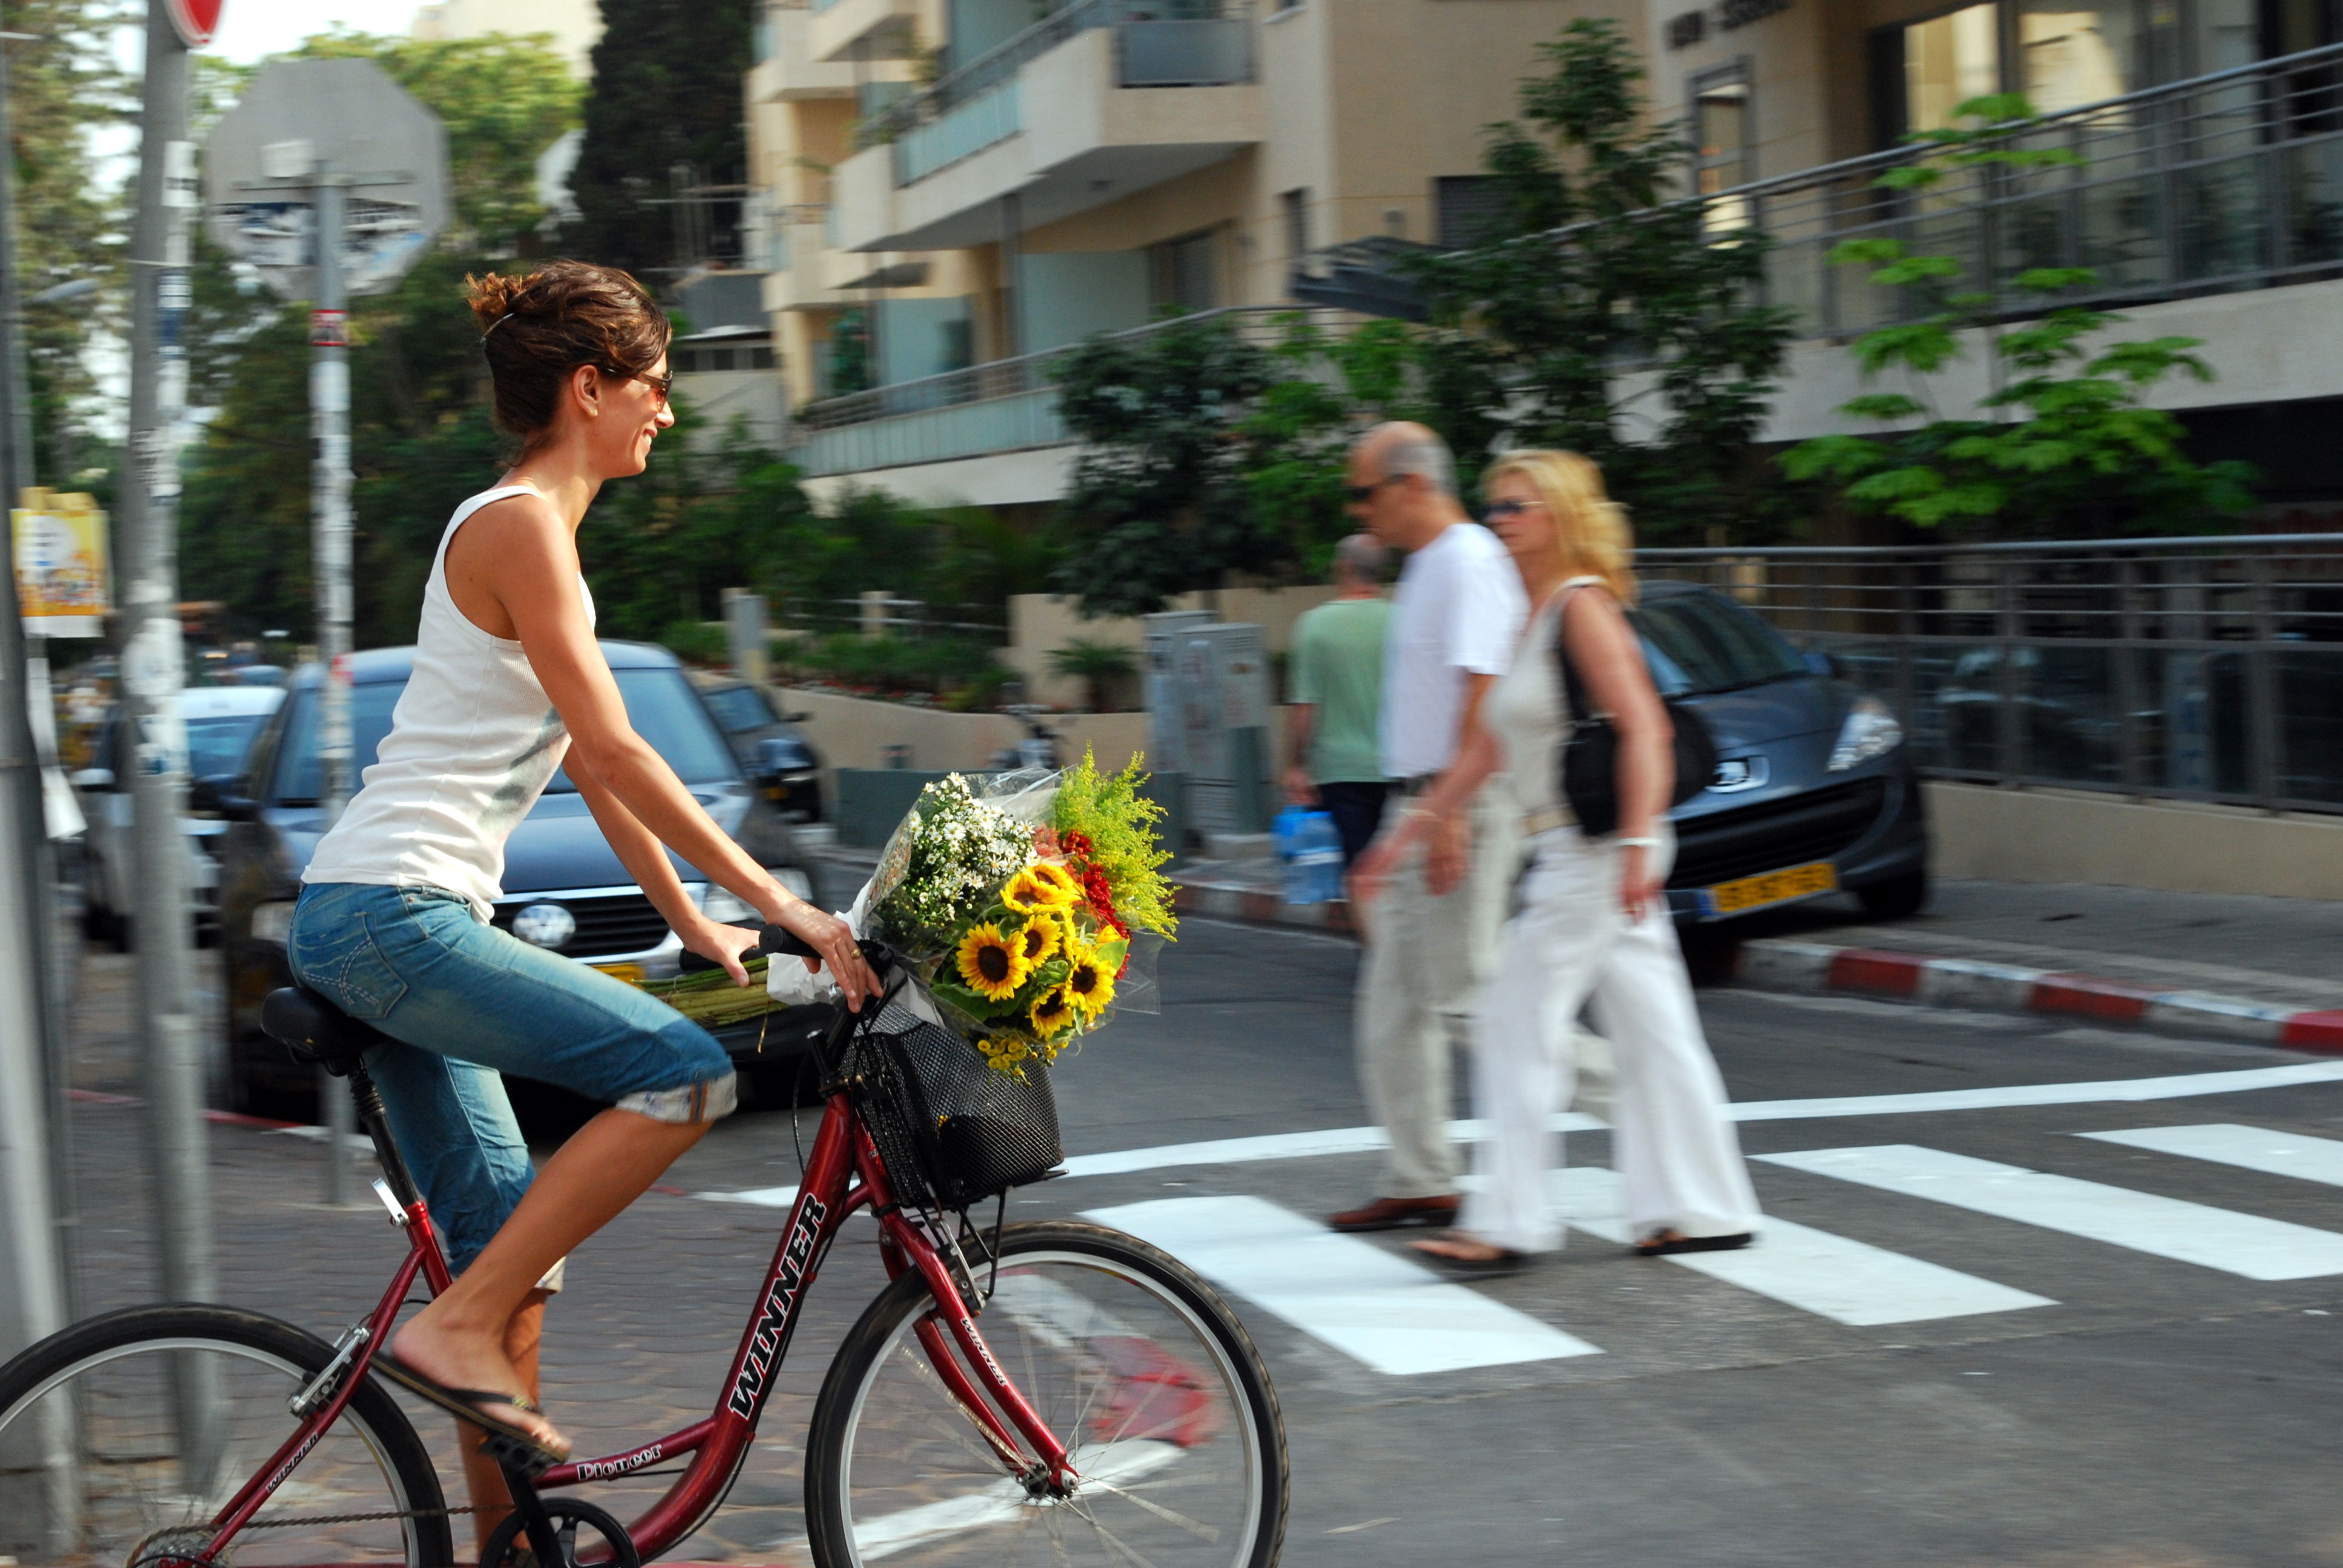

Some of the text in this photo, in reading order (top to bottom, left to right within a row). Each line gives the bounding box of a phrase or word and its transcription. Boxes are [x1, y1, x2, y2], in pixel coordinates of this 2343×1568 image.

[728, 1192, 827, 1420] WINNER
[960, 1318, 1008, 1387] WINNER
[266, 1431, 318, 1493] WINNER
[577, 1444, 662, 1481] Pioneer
